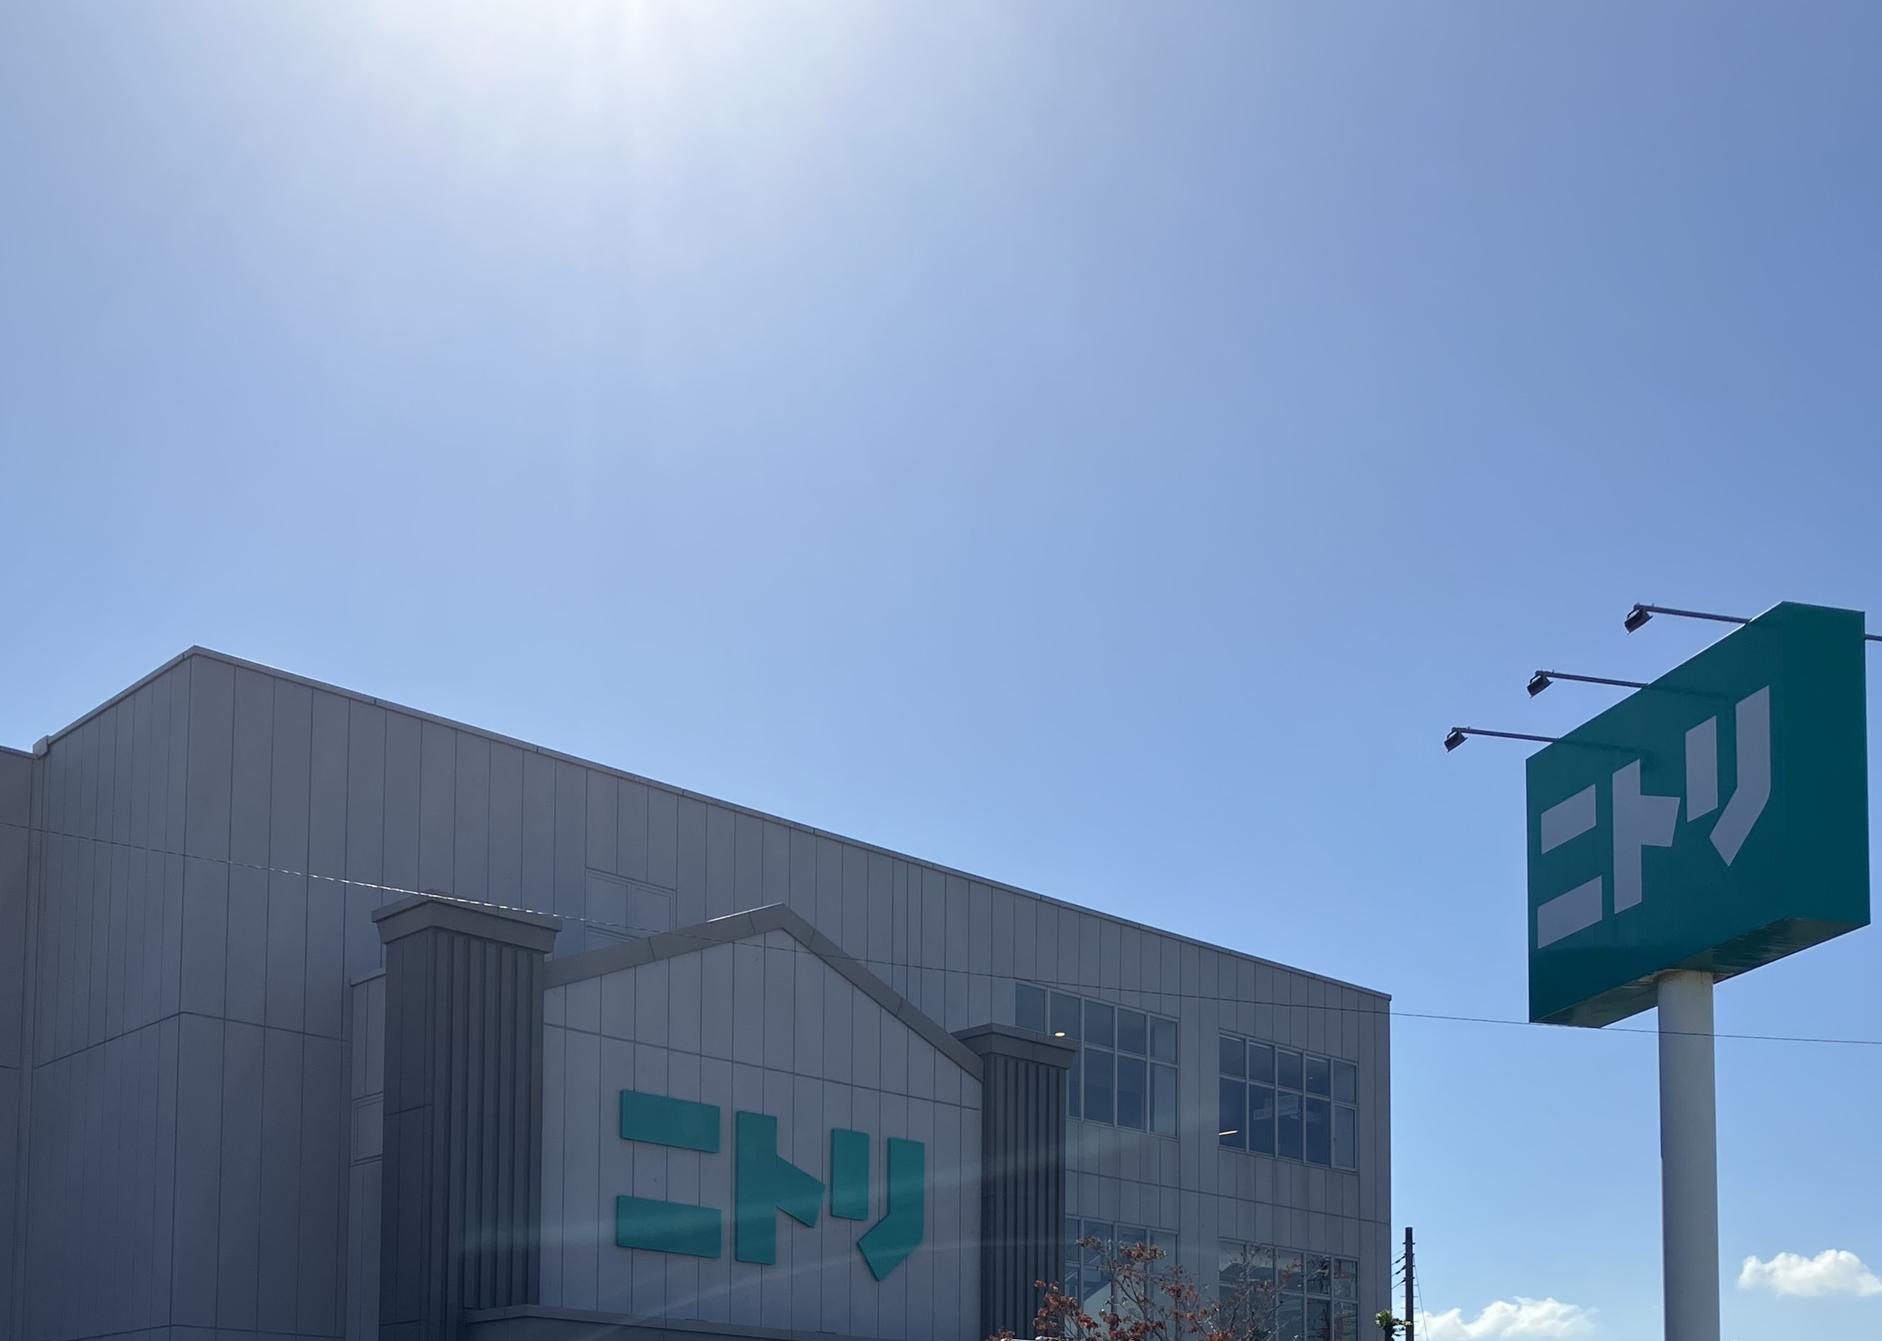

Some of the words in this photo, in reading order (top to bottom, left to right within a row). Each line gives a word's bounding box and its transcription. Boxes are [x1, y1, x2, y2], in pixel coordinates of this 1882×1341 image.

[1537, 685, 1772, 949] ニトリ
[616, 1090, 926, 1281] ニトリ
